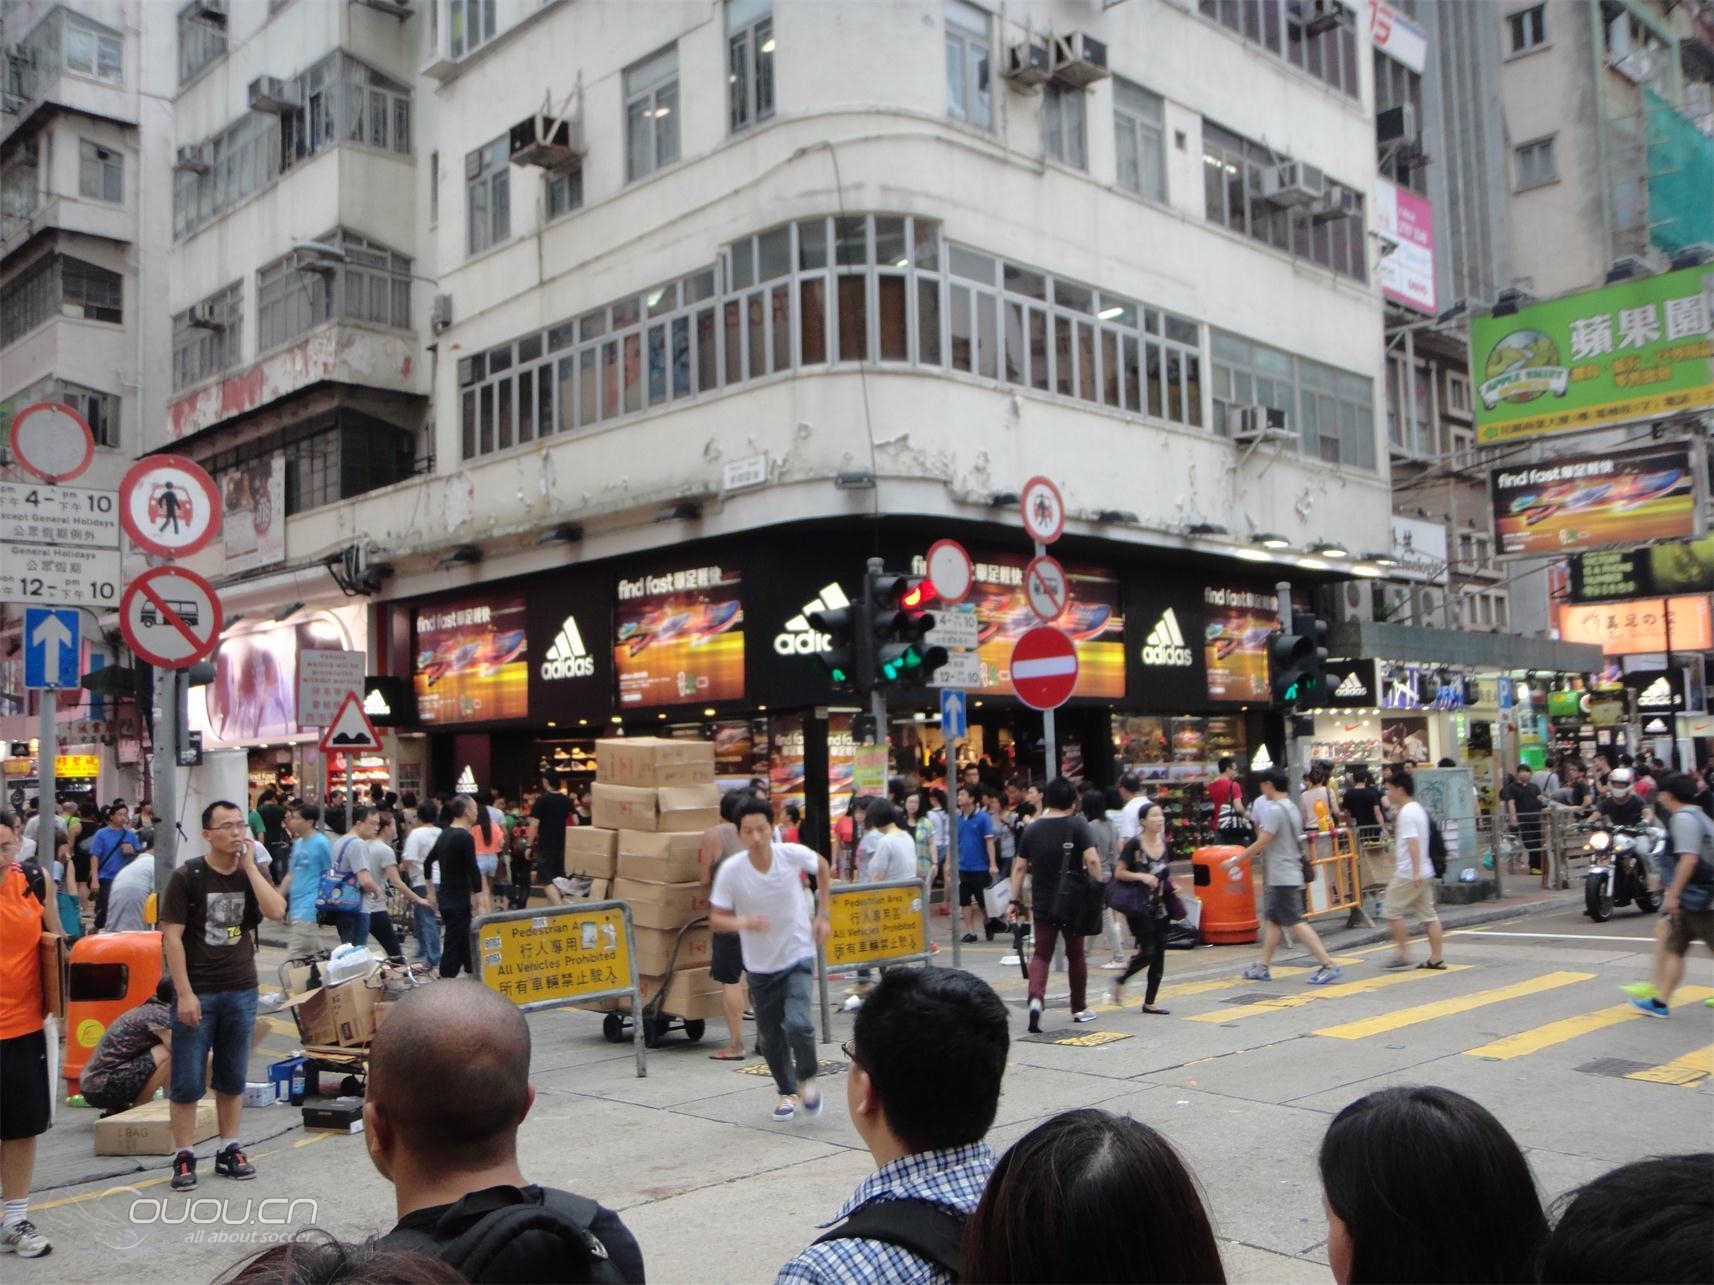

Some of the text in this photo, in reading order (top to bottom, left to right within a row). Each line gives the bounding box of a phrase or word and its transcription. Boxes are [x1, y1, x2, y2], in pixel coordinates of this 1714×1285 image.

[1569, 292, 1713, 361] 蘋果園
[1498, 470, 1528, 488] find
[1529, 466, 1560, 485] fast
[88, 494, 112, 513] 10
[32, 514, 70, 522] General
[73, 517, 115, 528] Holidays
[12, 546, 96, 561] General Holidays
[91, 582, 115, 600] 10
[618, 577, 644, 600] find
[645, 573, 674, 595] fast
[1204, 586, 1225, 606] find
[1225, 589, 1247, 608] fast
[416, 614, 435, 633] find
[437, 611, 457, 630] fast
[1141, 646, 1193, 666] adidas
[540, 655, 595, 680] adidas
[1335, 686, 1367, 697] adidas
[844, 896, 885, 907] Pedestrian
[511, 922, 569, 939] Pedestrian
[833, 922, 916, 938] All Vehicles Prohibited
[520, 936, 594, 960] 行人專用
[498, 951, 617, 976] All Vehicles Prohibited
